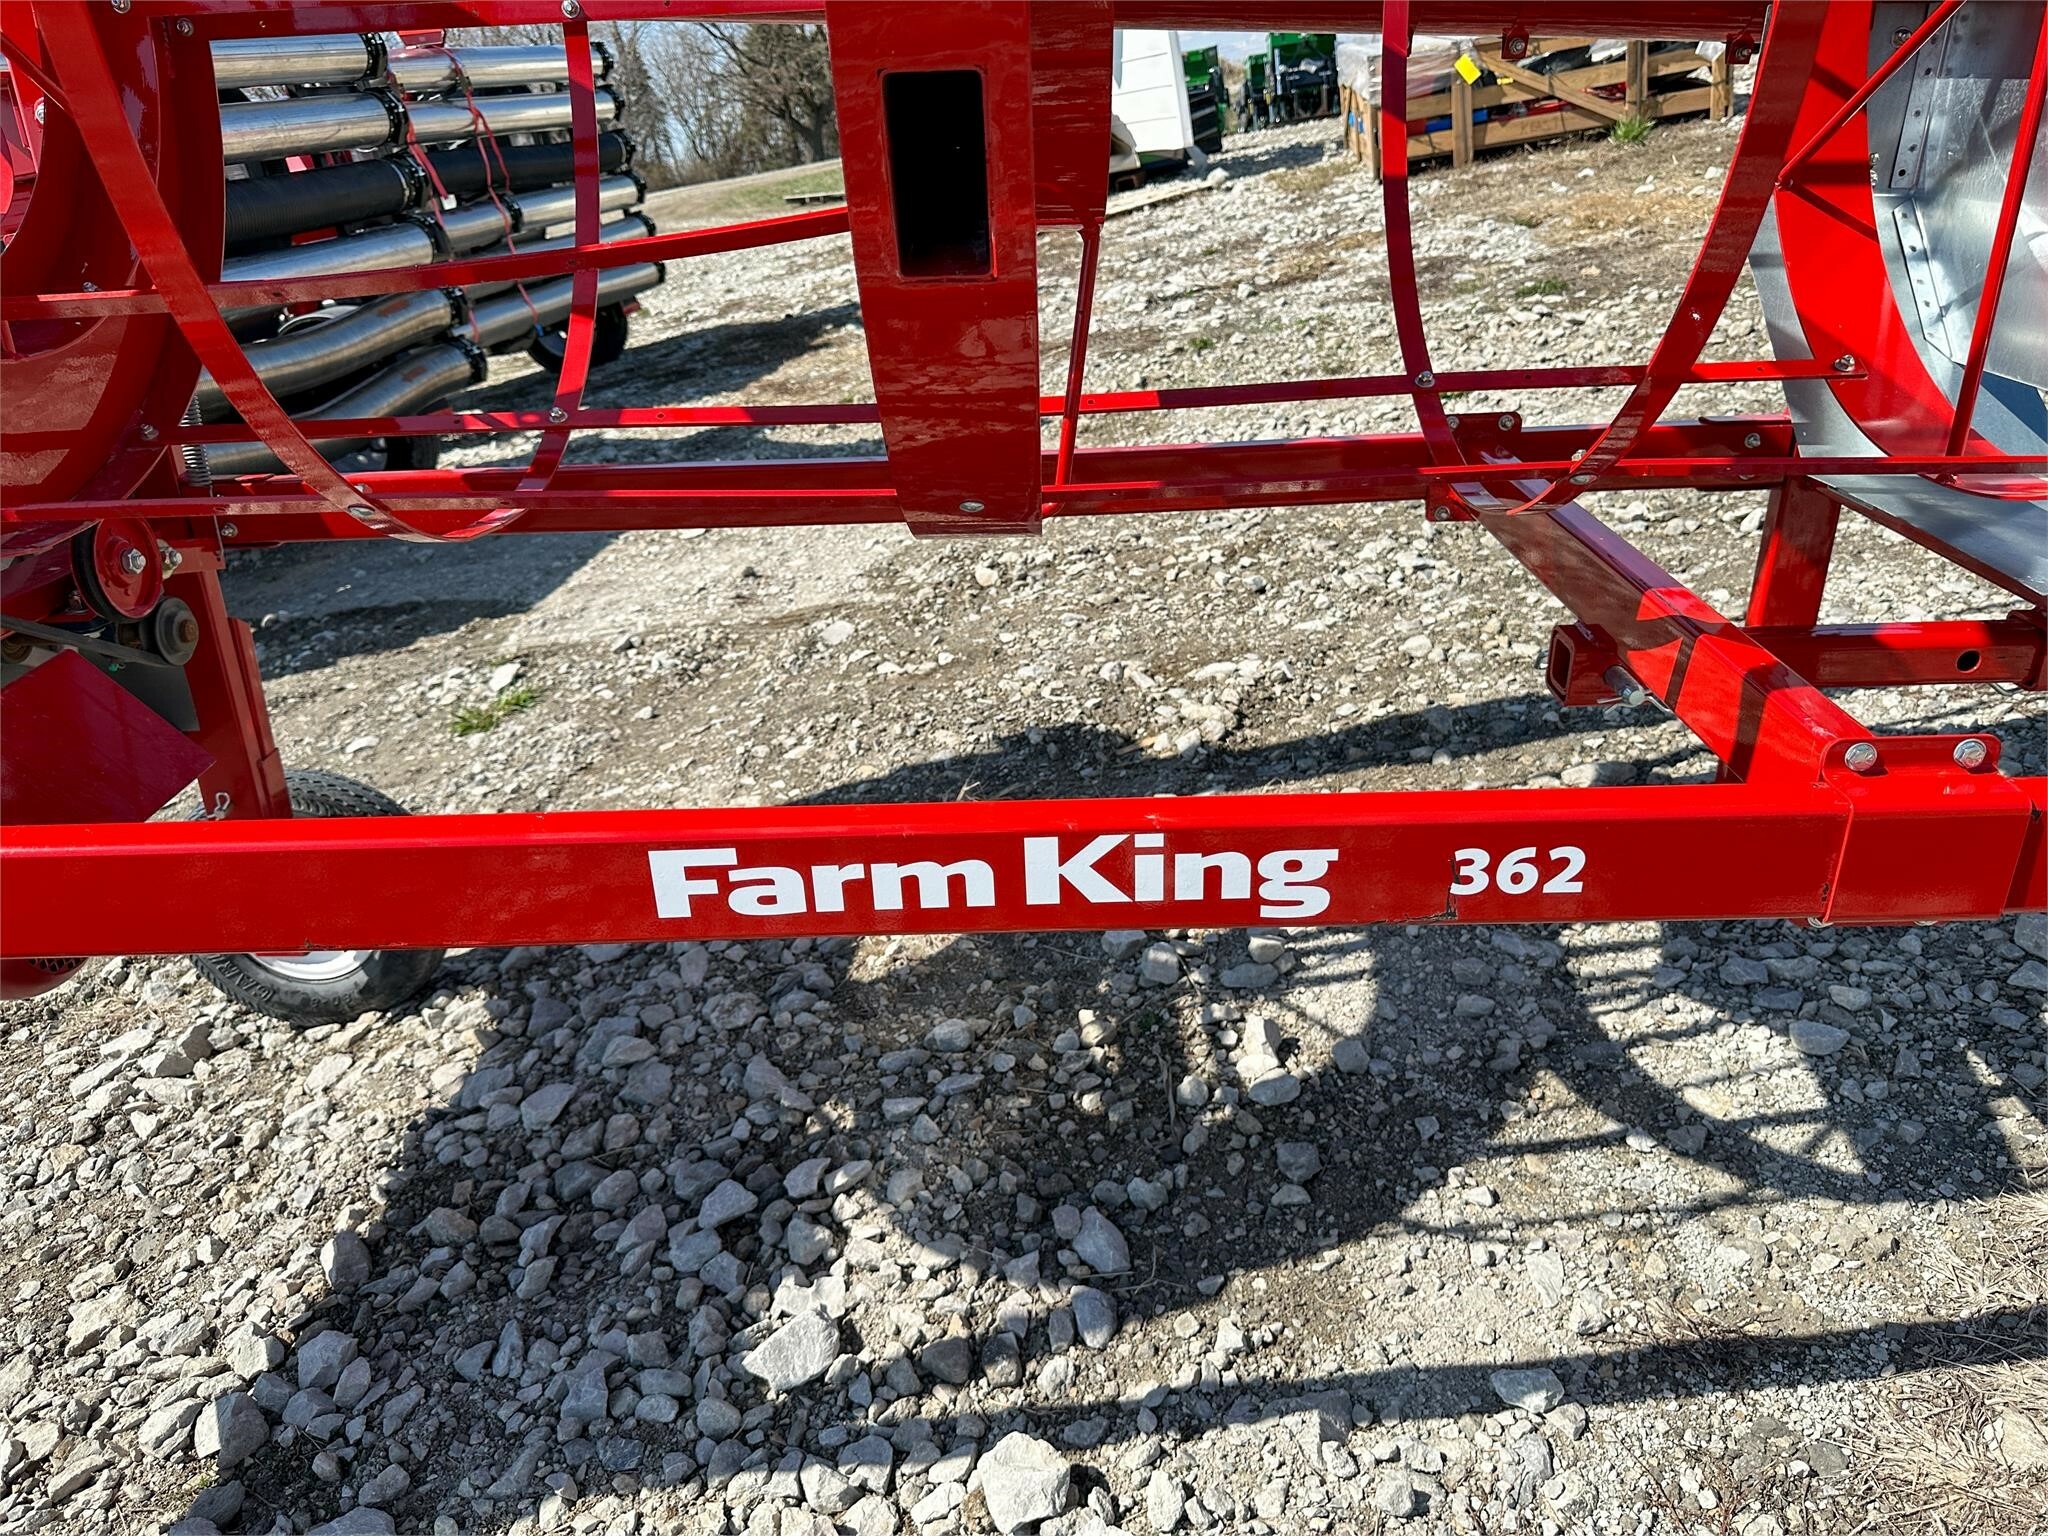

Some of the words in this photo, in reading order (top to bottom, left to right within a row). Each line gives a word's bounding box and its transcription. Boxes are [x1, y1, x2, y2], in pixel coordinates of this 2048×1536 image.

[647, 847, 996, 919] Farm
[1023, 832, 1339, 919] King
[1449, 845, 1586, 896] 362
